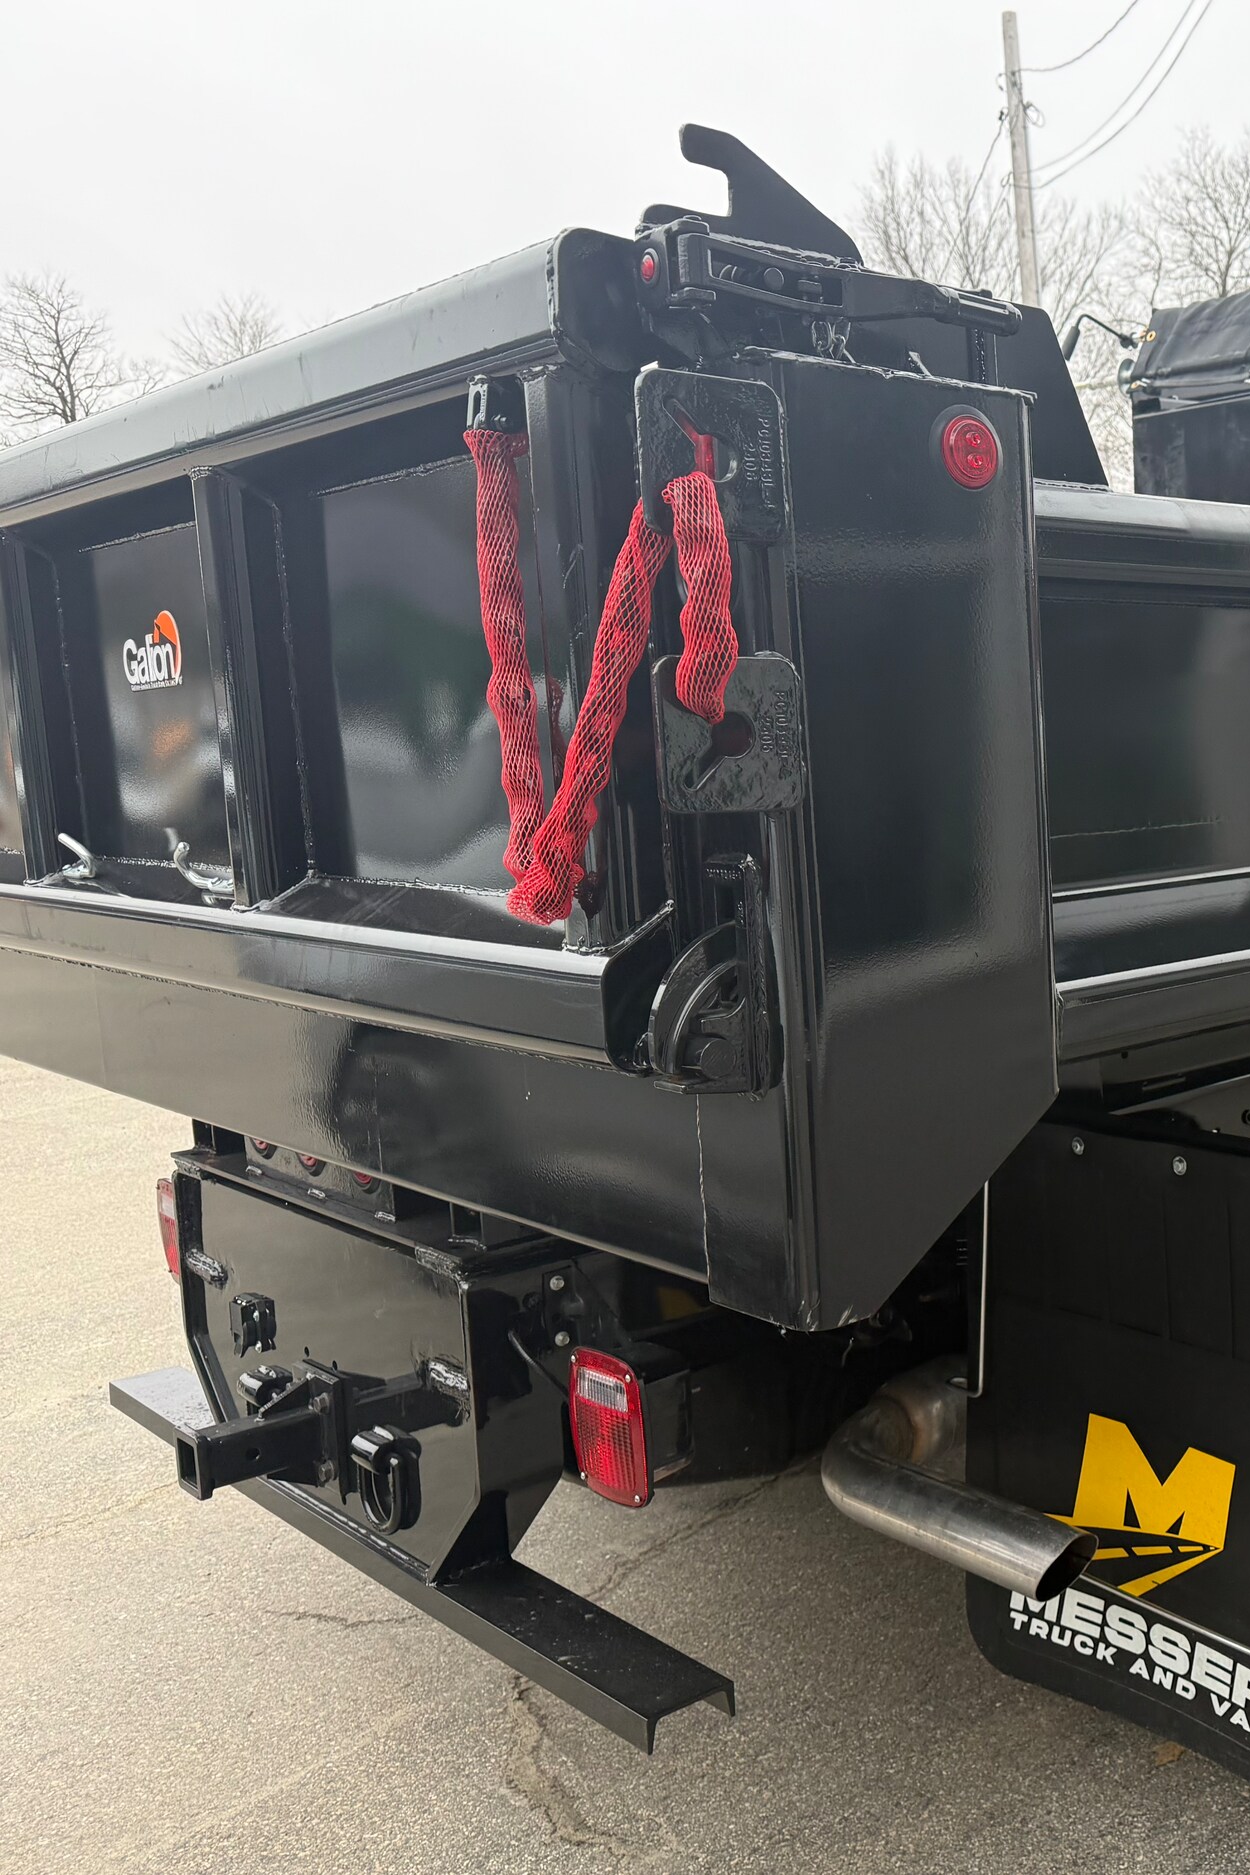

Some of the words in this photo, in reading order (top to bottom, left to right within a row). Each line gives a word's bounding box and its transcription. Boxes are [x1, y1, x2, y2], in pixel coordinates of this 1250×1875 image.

[122, 633, 177, 685] Galion
[1009, 1610, 1118, 1666] TRUCK
[1128, 1657, 1197, 1701] AND
